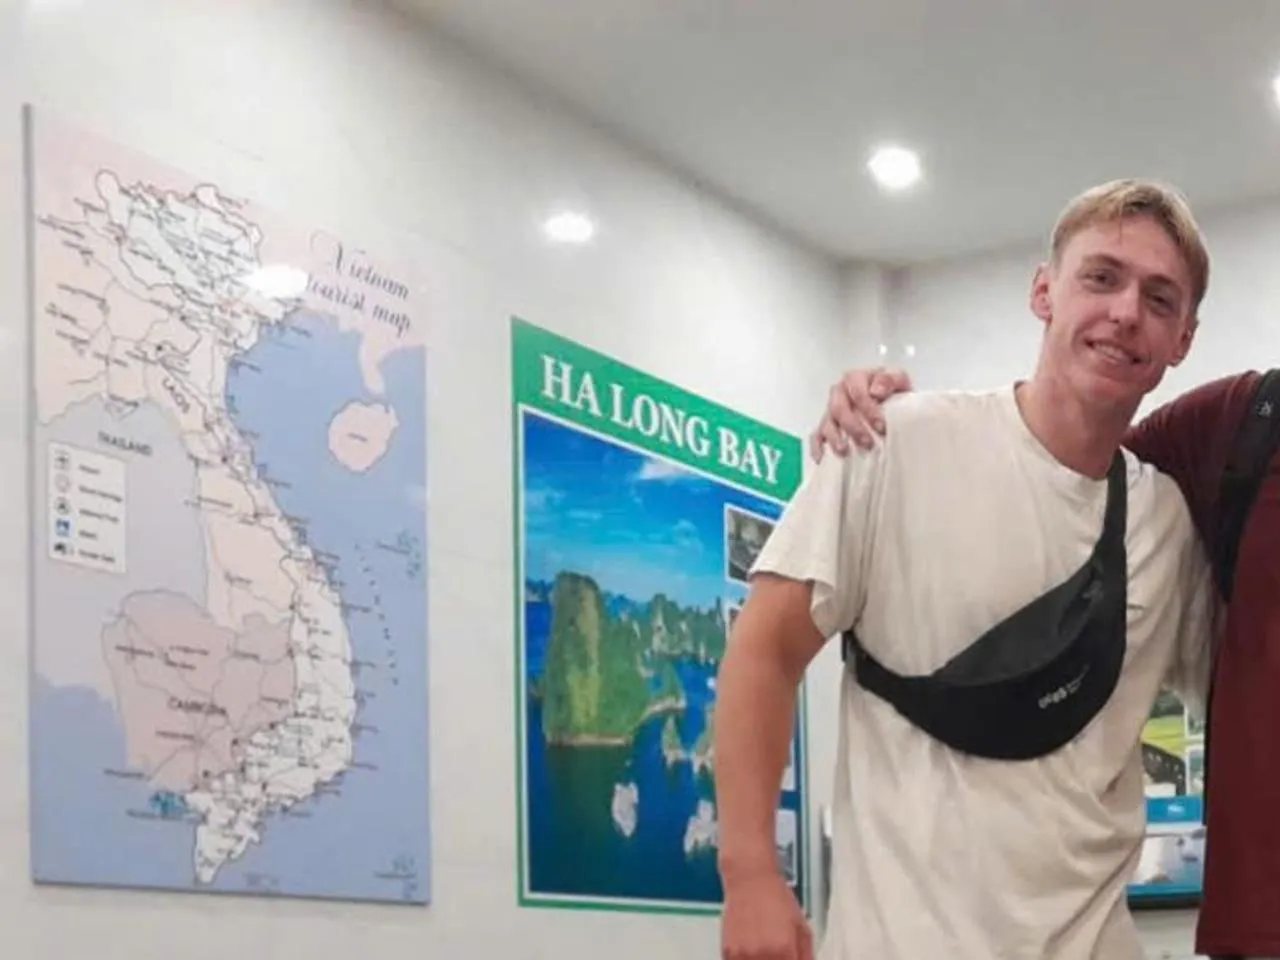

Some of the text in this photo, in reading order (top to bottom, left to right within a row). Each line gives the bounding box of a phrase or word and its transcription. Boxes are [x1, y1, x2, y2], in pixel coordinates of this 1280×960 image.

[372, 304, 411, 338] map
[541, 353, 783, 484] HA LONG BAY
